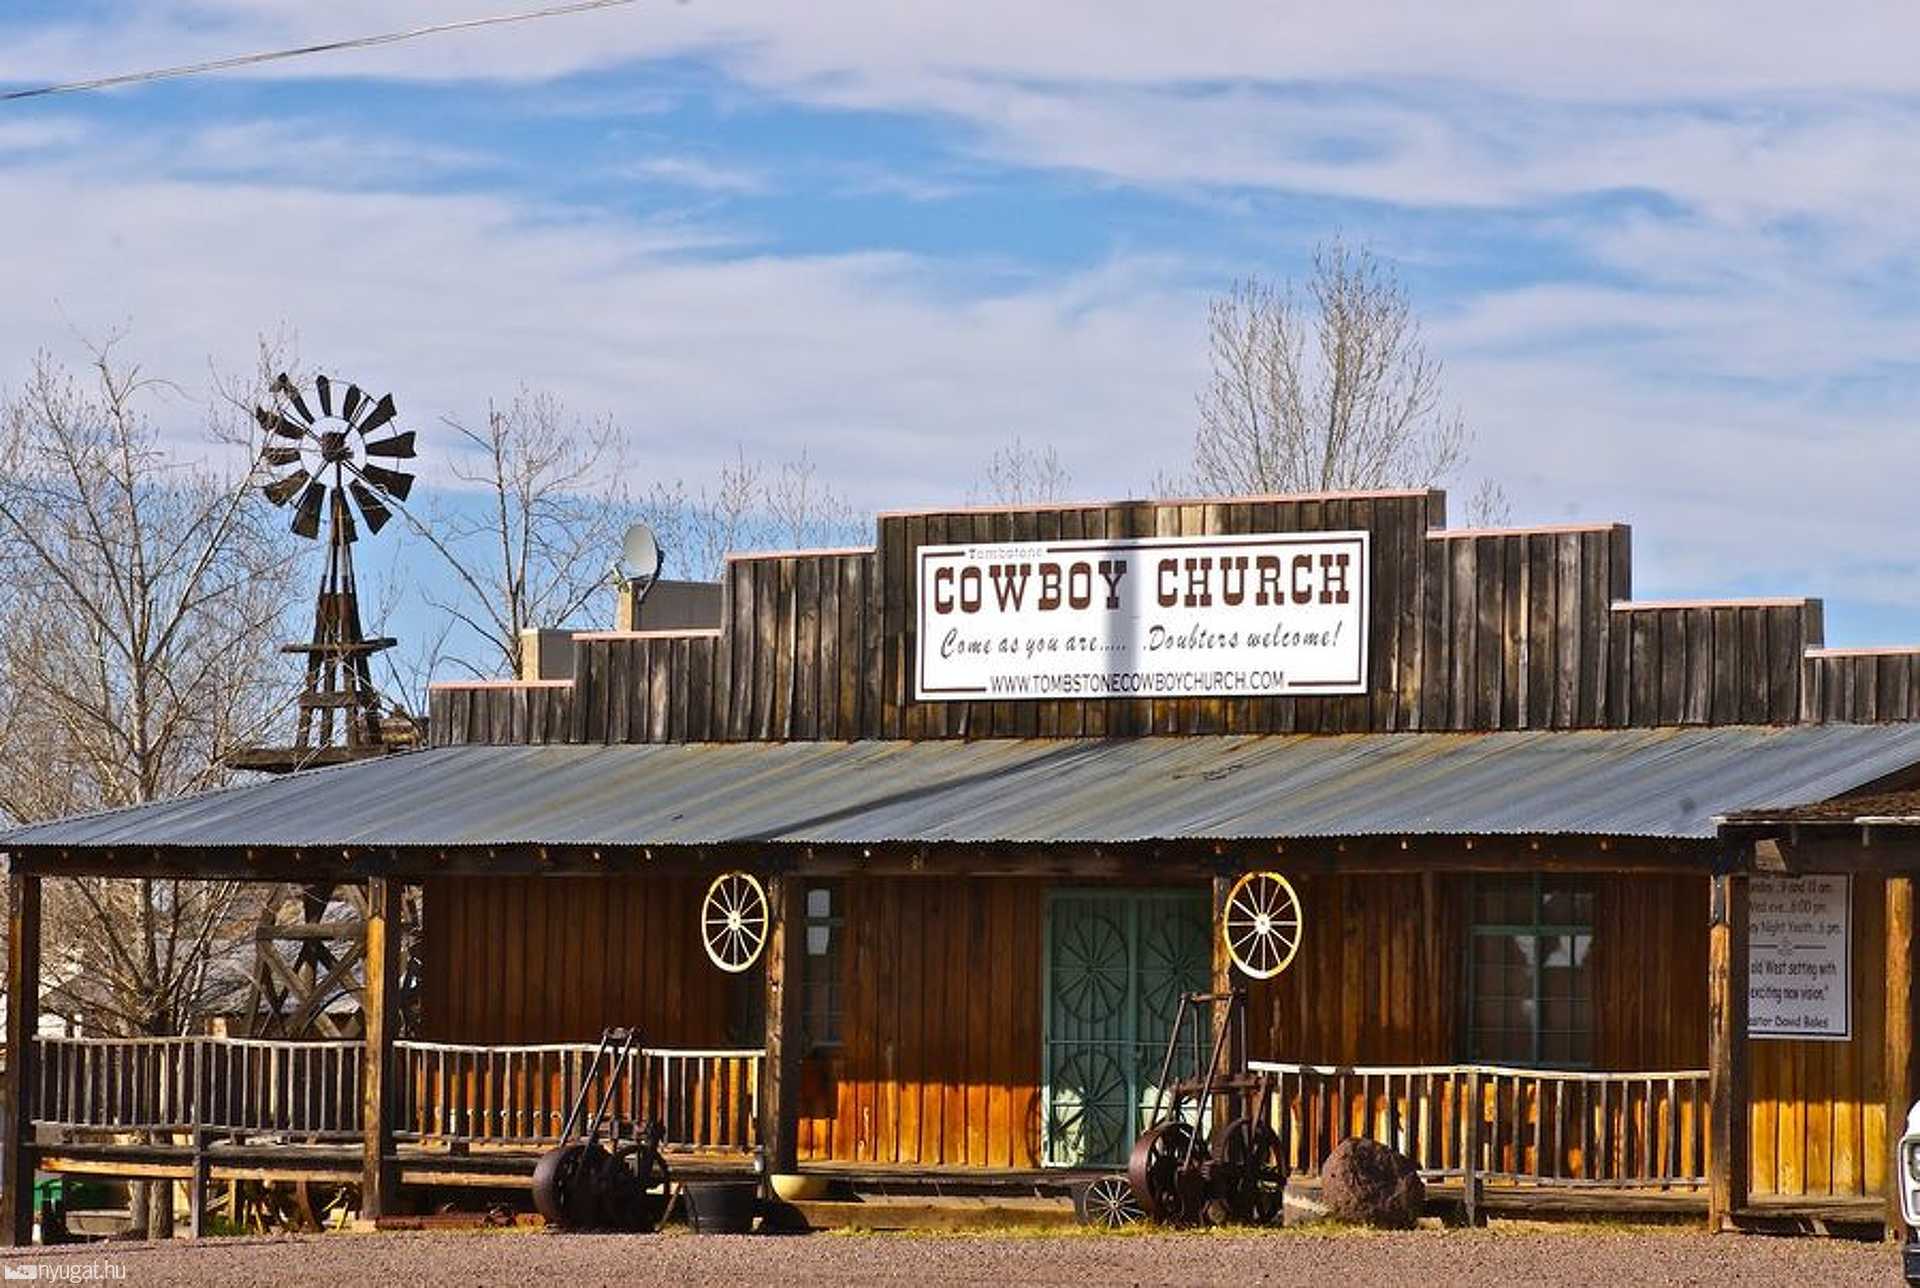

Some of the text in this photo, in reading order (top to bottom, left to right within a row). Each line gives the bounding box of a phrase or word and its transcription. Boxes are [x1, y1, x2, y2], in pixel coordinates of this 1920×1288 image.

[933, 553, 1350, 615] COWBOY CHURCH
[940, 627, 993, 660] Come
[998, 636, 1019, 655] as
[1025, 636, 1059, 660] you
[1247, 619, 1343, 650] welcome!
[989, 670, 1285, 694] WWW.TOMBSTONECOWBOYCHURCH.COM
[1765, 960, 1786, 975] West
[1787, 960, 1818, 981] setting
[1818, 961, 1837, 976] with
[1775, 1014, 1801, 1026] David
